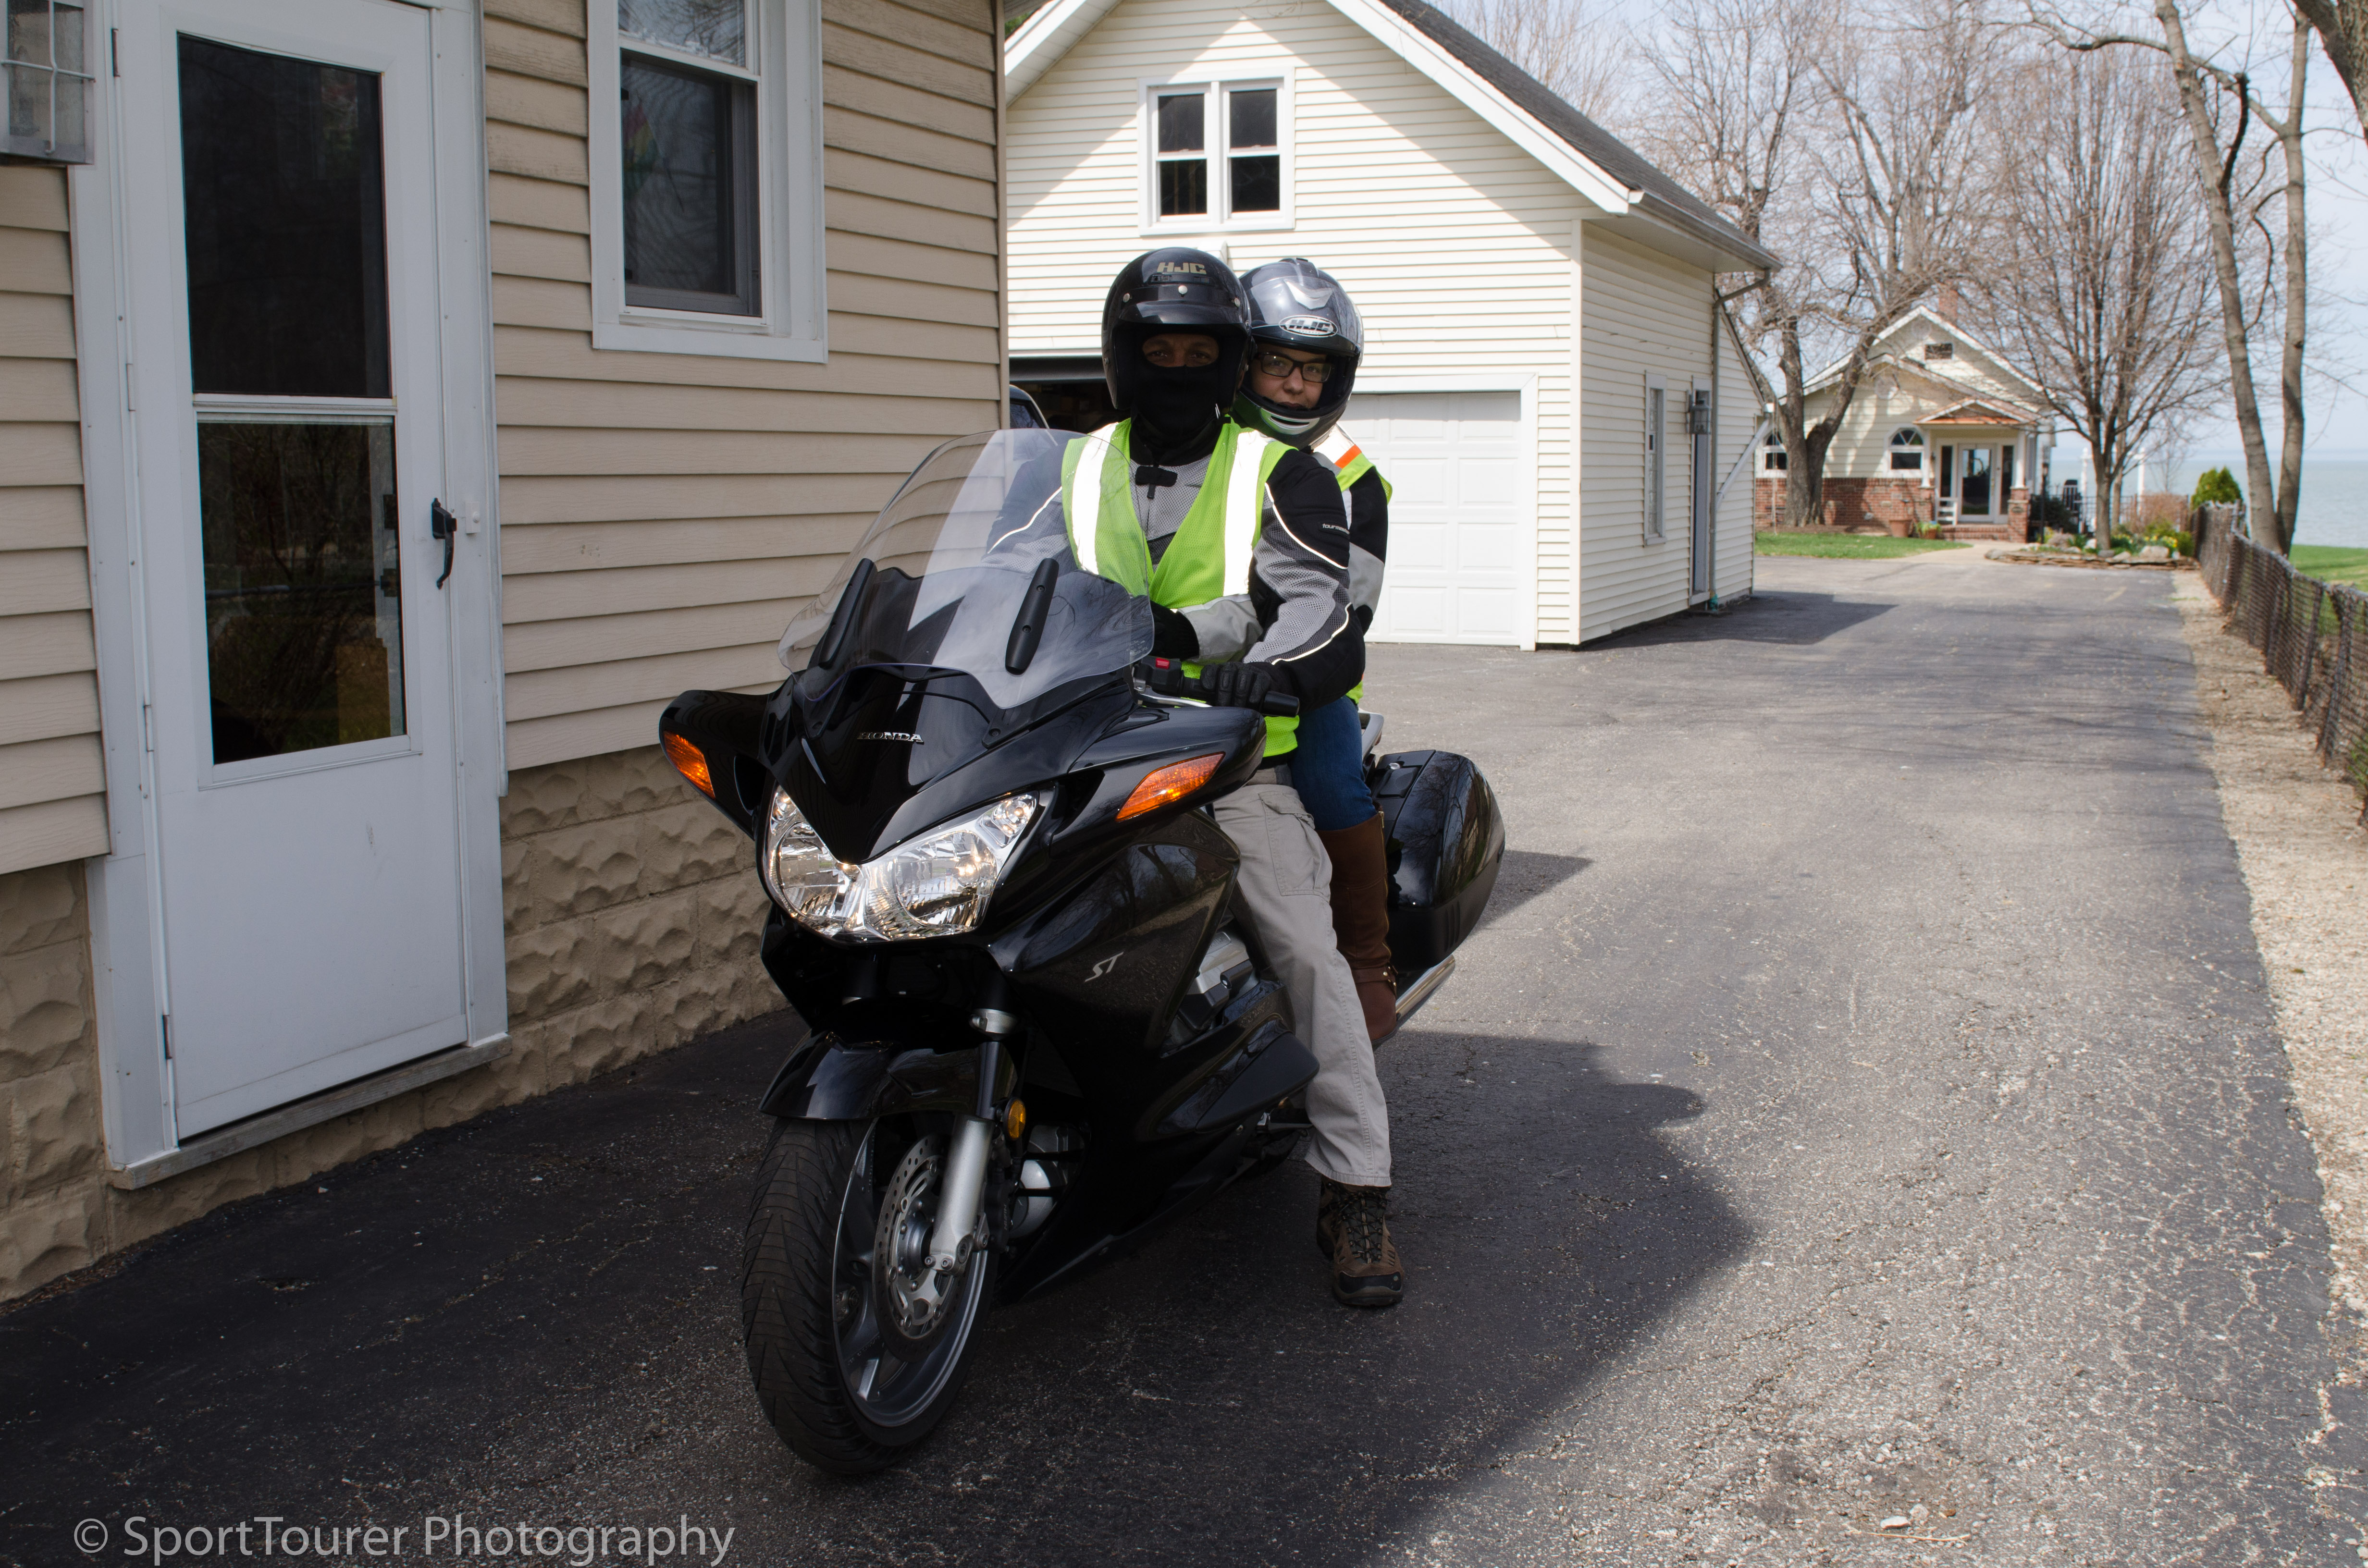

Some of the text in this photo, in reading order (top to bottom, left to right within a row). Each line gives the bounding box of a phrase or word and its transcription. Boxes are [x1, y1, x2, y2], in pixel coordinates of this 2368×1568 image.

[1157, 262, 1207, 275] HJC
[1289, 319, 1331, 332] HJC
[857, 732, 924, 743] HONDA
[1084, 952, 1124, 982] ST
